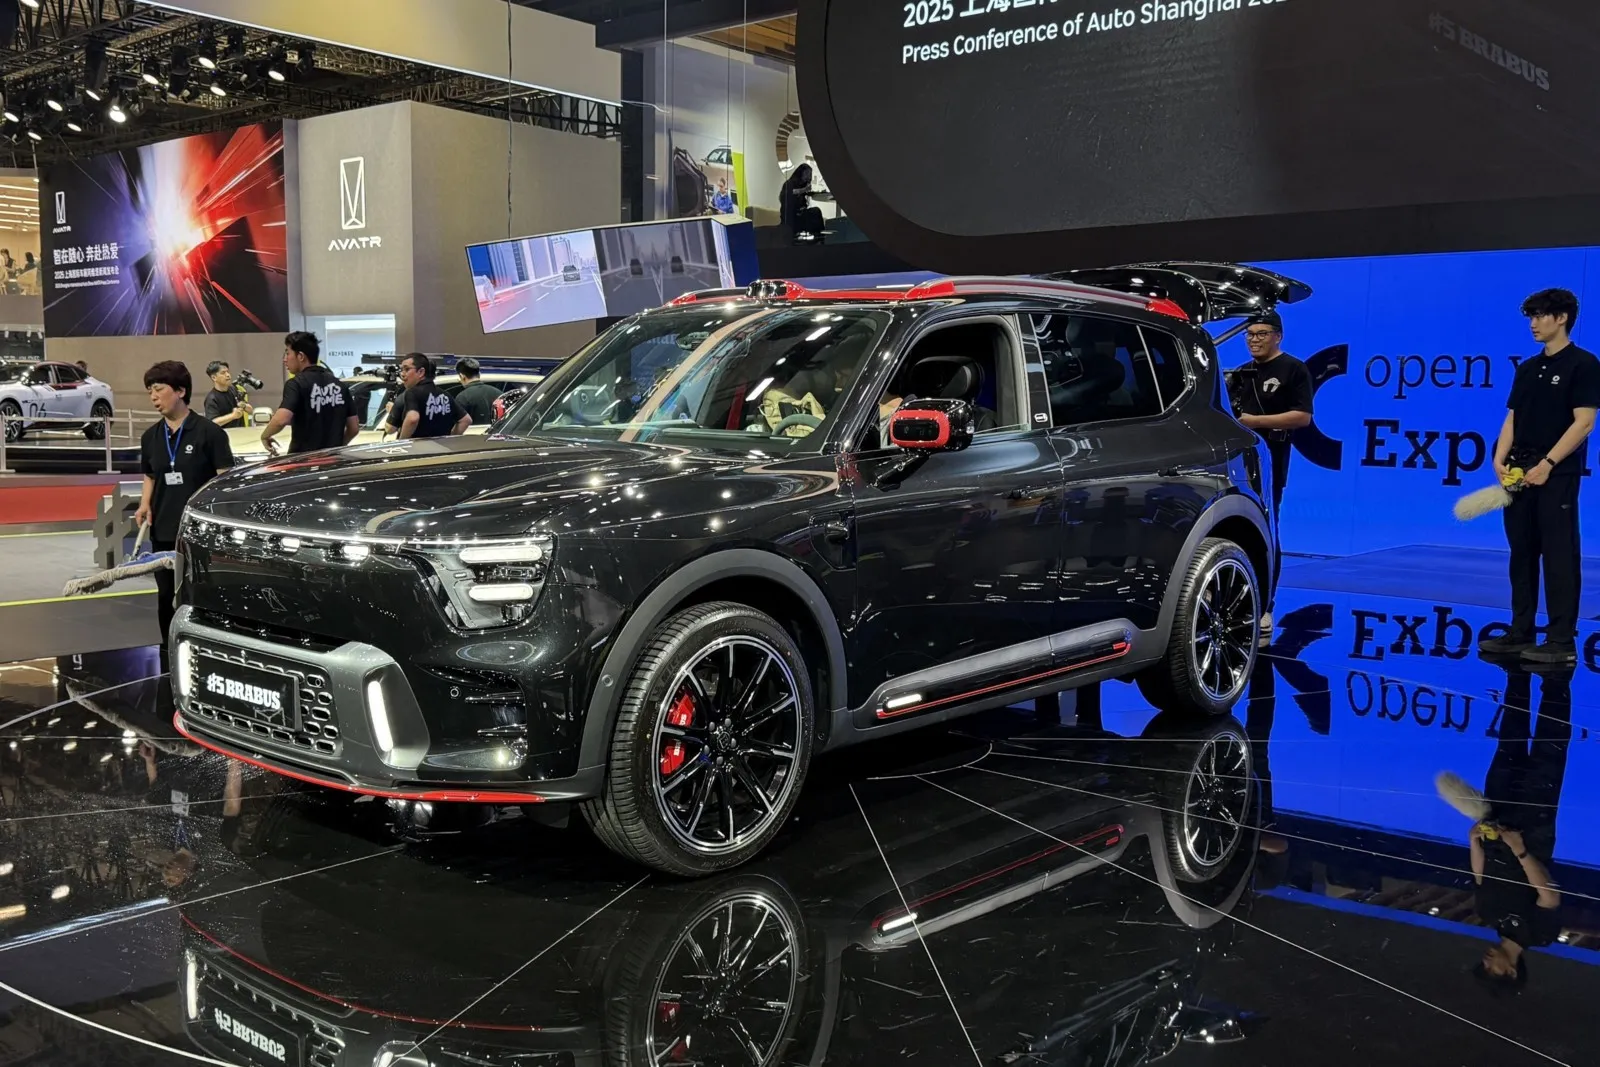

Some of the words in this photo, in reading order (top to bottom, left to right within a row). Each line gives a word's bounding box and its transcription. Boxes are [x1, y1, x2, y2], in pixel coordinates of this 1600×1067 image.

[903, 0, 954, 28] 2025
[902, 41, 950, 64] Press
[953, 23, 1058, 56] Conference
[1062, 12, 1085, 37] of
[1086, 7, 1136, 33] Auto
[1459, 25, 1550, 91] BRABUS
[328, 236, 382, 251] AVATR
[1365, 354, 1493, 400] open
[206, 672, 225, 696] #5
[225, 678, 281, 710] BRABUS
